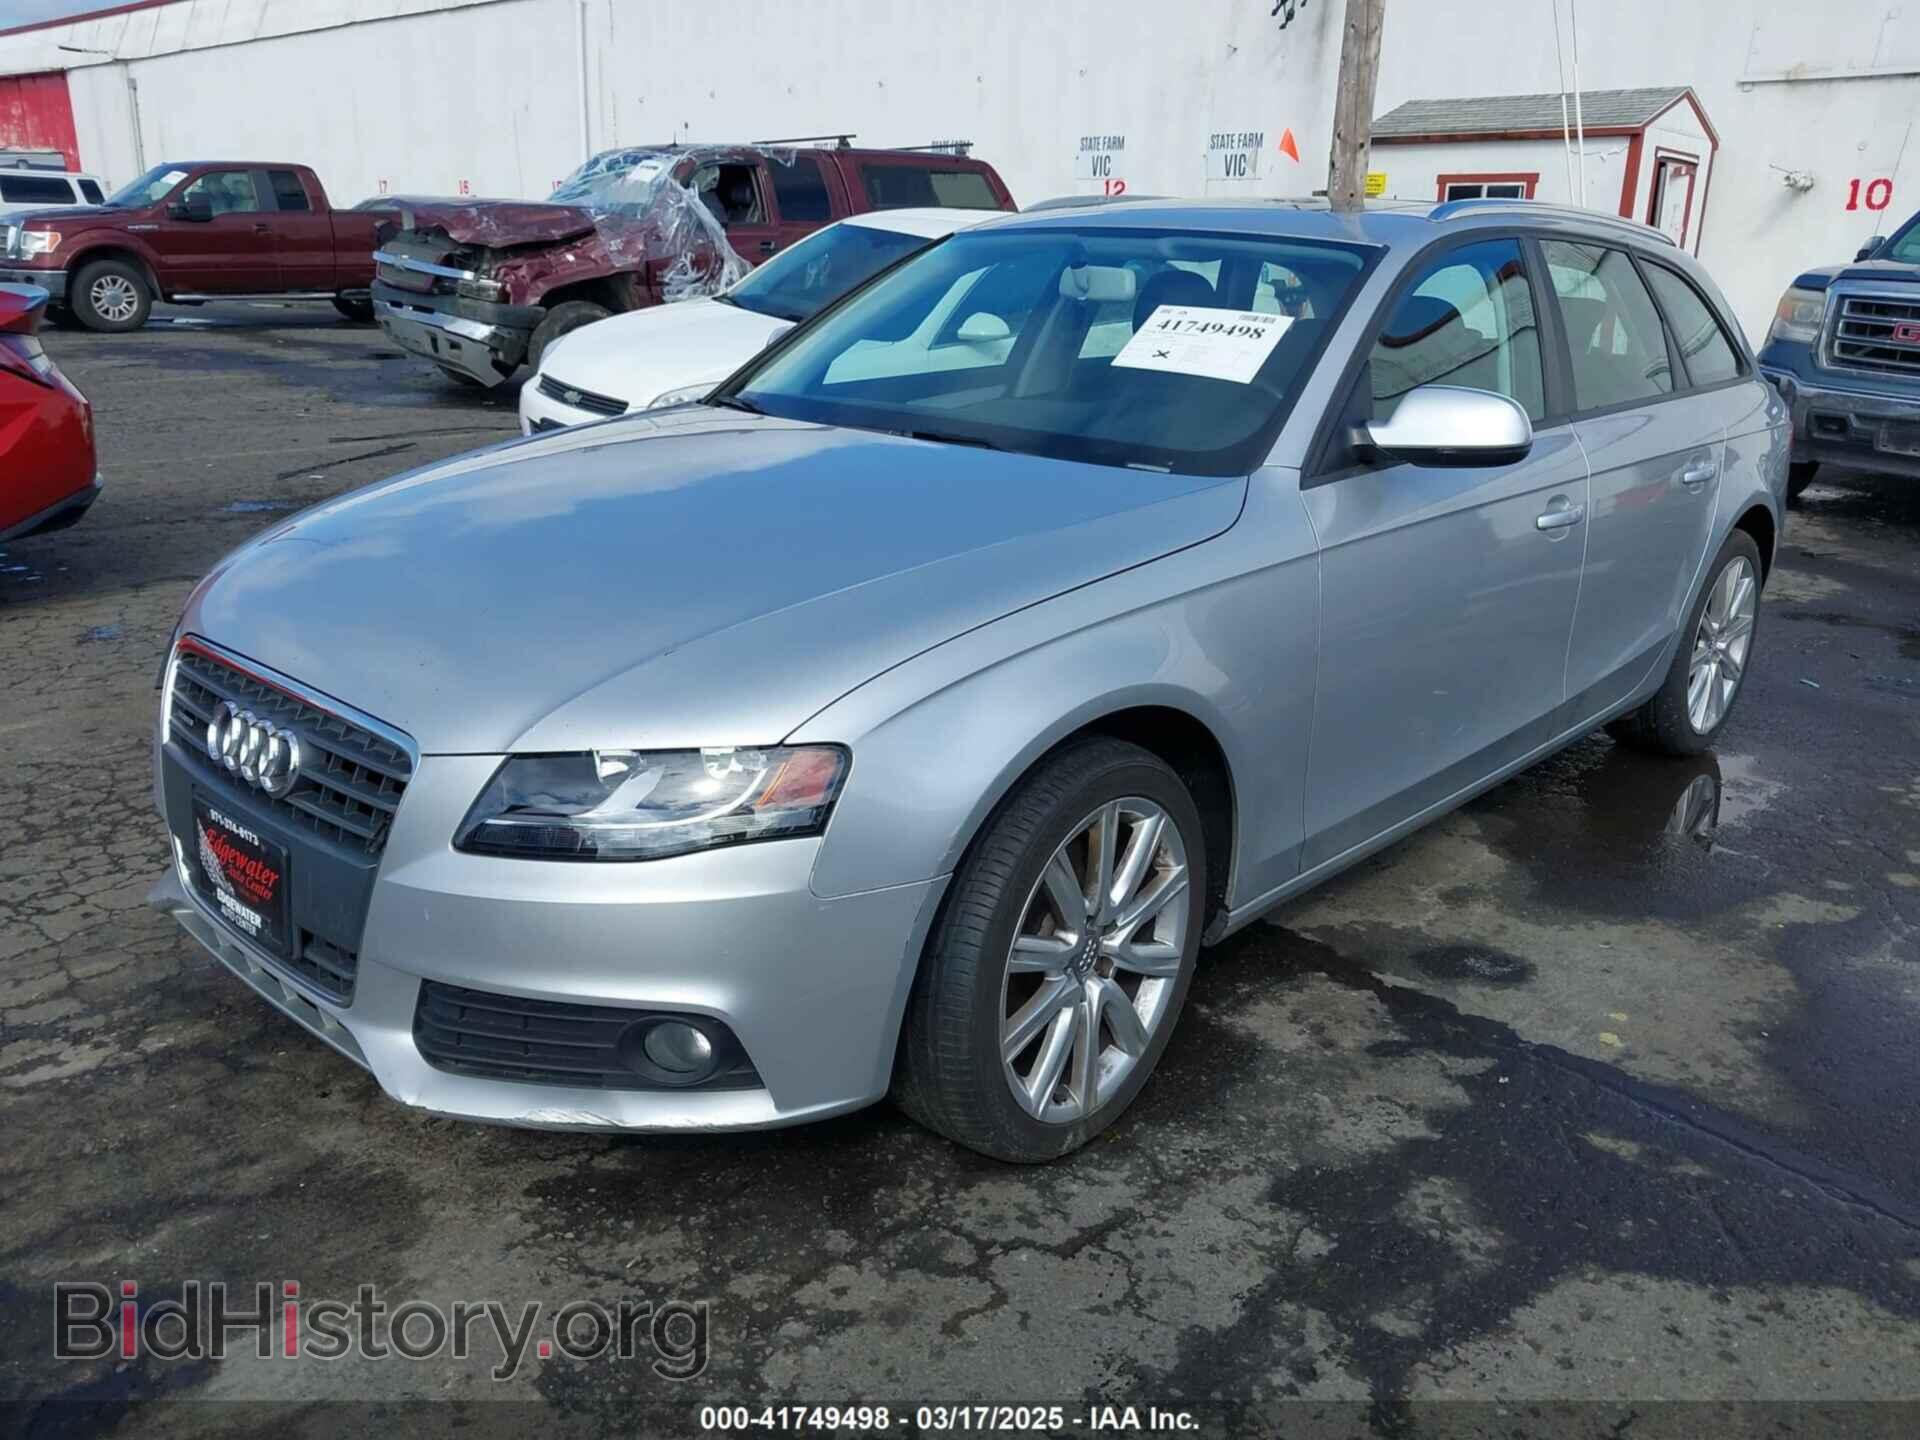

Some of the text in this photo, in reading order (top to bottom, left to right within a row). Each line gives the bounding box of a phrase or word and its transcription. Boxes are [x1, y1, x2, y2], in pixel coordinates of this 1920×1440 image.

[1080, 135, 1125, 151] STATE FARM
[1210, 132, 1263, 149] STATE FARM
[1091, 155, 1111, 177] VIC
[1225, 154, 1247, 177] VIC
[1104, 180, 1126, 196] 12
[1846, 179, 1893, 211] 10
[1158, 319, 1266, 340] 41749498
[207, 828, 279, 887] Edgewater
[216, 887, 262, 929] EDGEWATER
